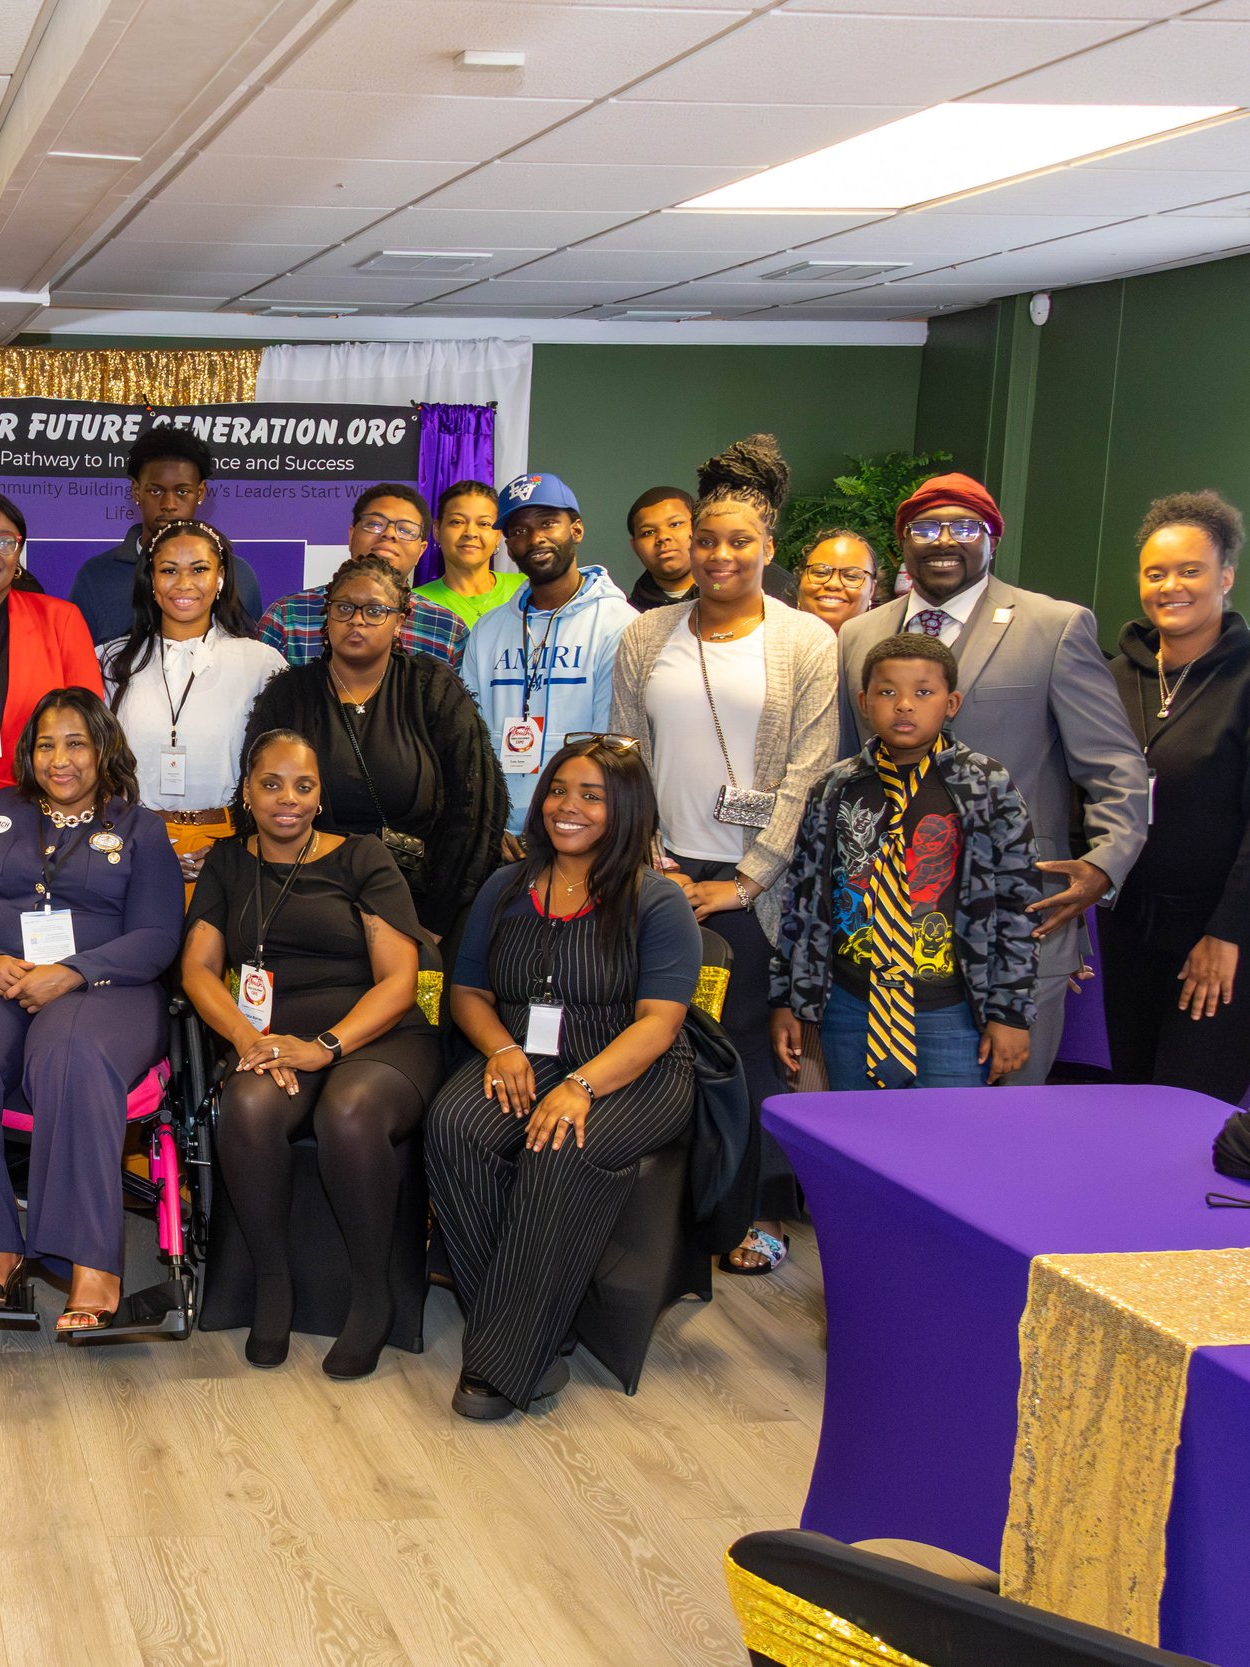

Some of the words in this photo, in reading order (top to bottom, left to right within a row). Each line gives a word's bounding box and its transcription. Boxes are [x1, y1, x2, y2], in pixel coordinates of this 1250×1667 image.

[28, 412, 143, 444] FUTURE
[1, 451, 80, 471] Pathway
[84, 453, 103, 468] to
[245, 454, 280, 470] and
[284, 456, 355, 471] Success
[68, 482, 133, 500] Building
[235, 485, 297, 499] Leaders
[301, 485, 341, 498] Start
[105, 506, 135, 520] Life
[494, 645, 582, 670] AMIRI
